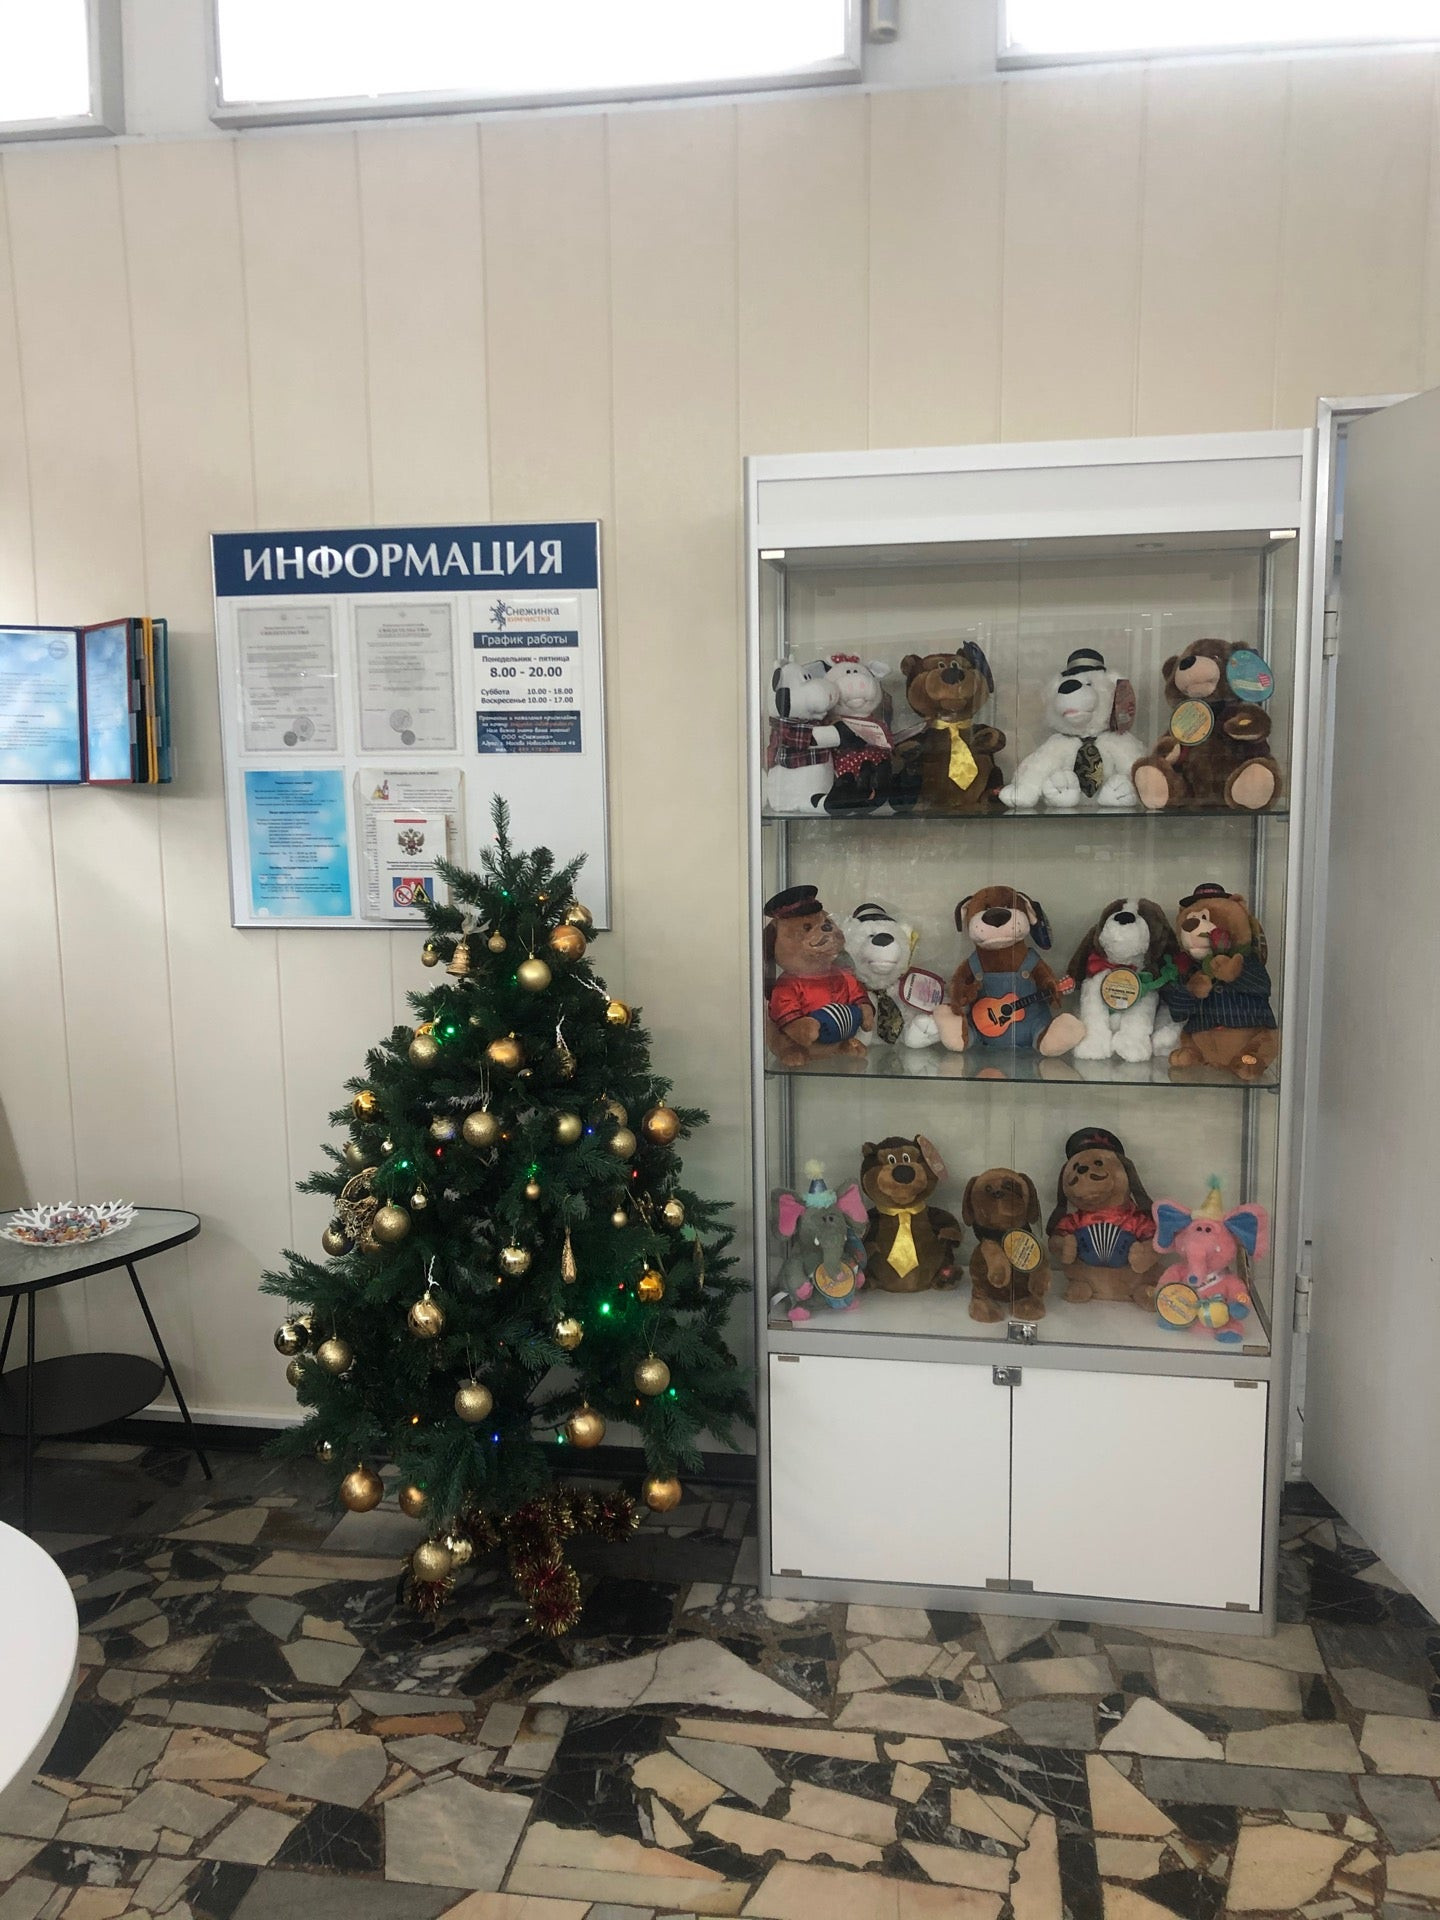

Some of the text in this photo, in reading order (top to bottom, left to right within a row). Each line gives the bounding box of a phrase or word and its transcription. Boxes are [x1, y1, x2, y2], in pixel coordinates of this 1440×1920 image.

[243, 540, 562, 581] ИНФОРМАЦИЯ
[506, 606, 560, 616] Снежинка
[481, 634, 568, 646] График работы
[490, 667, 517, 678] 8.00
[528, 666, 563, 677] 20.00
[480, 688, 510, 696] Суббота
[481, 697, 526, 705] Воскресенье
